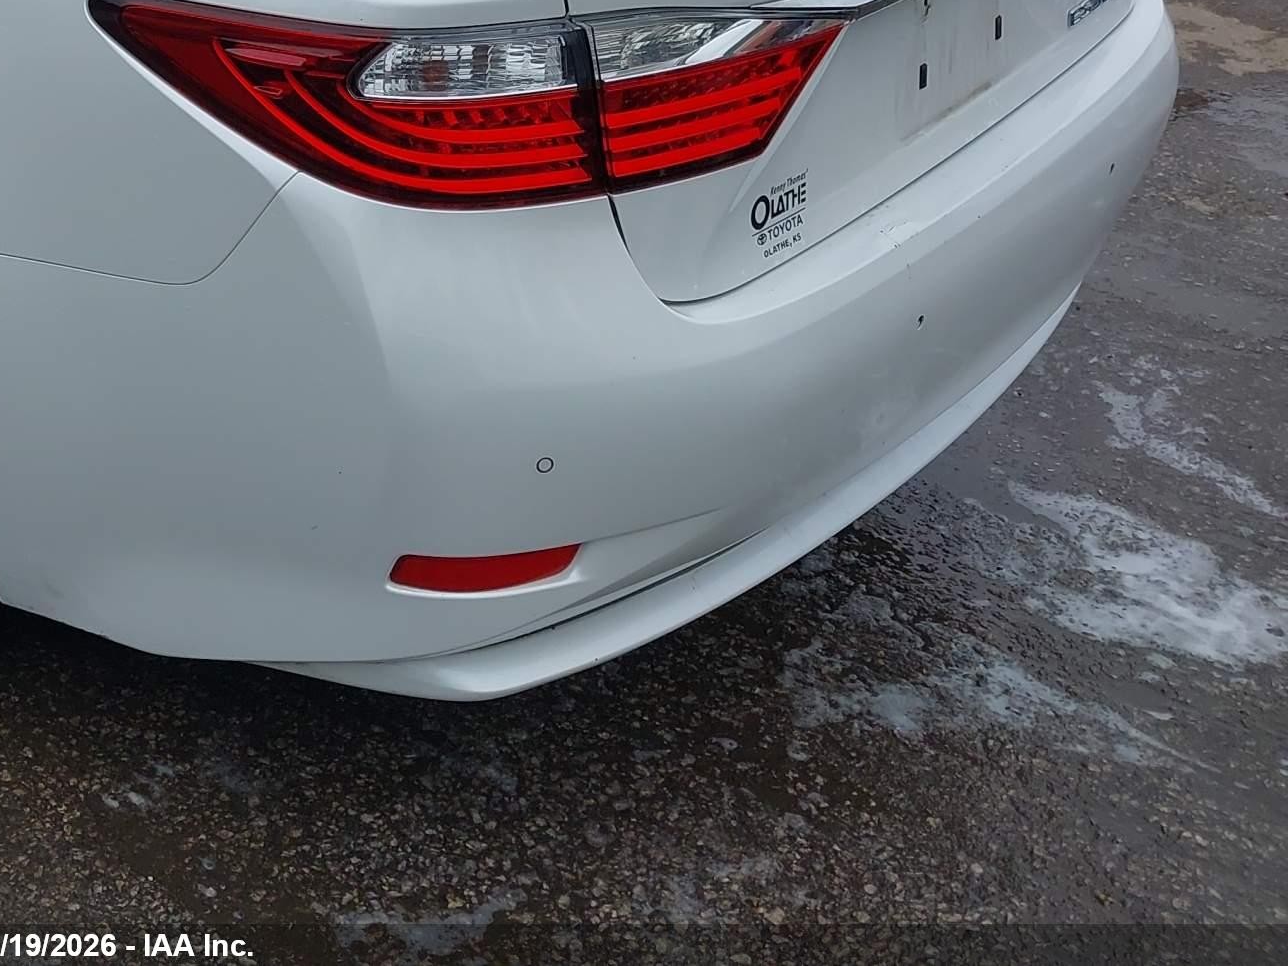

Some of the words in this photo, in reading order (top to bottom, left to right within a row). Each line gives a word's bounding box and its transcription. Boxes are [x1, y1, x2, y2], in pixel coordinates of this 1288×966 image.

[750, 181, 808, 231] OLATHE
[767, 214, 804, 241] TOYOTA
[763, 238, 793, 258] OLATHE,
[792, 232, 802, 244] KS
